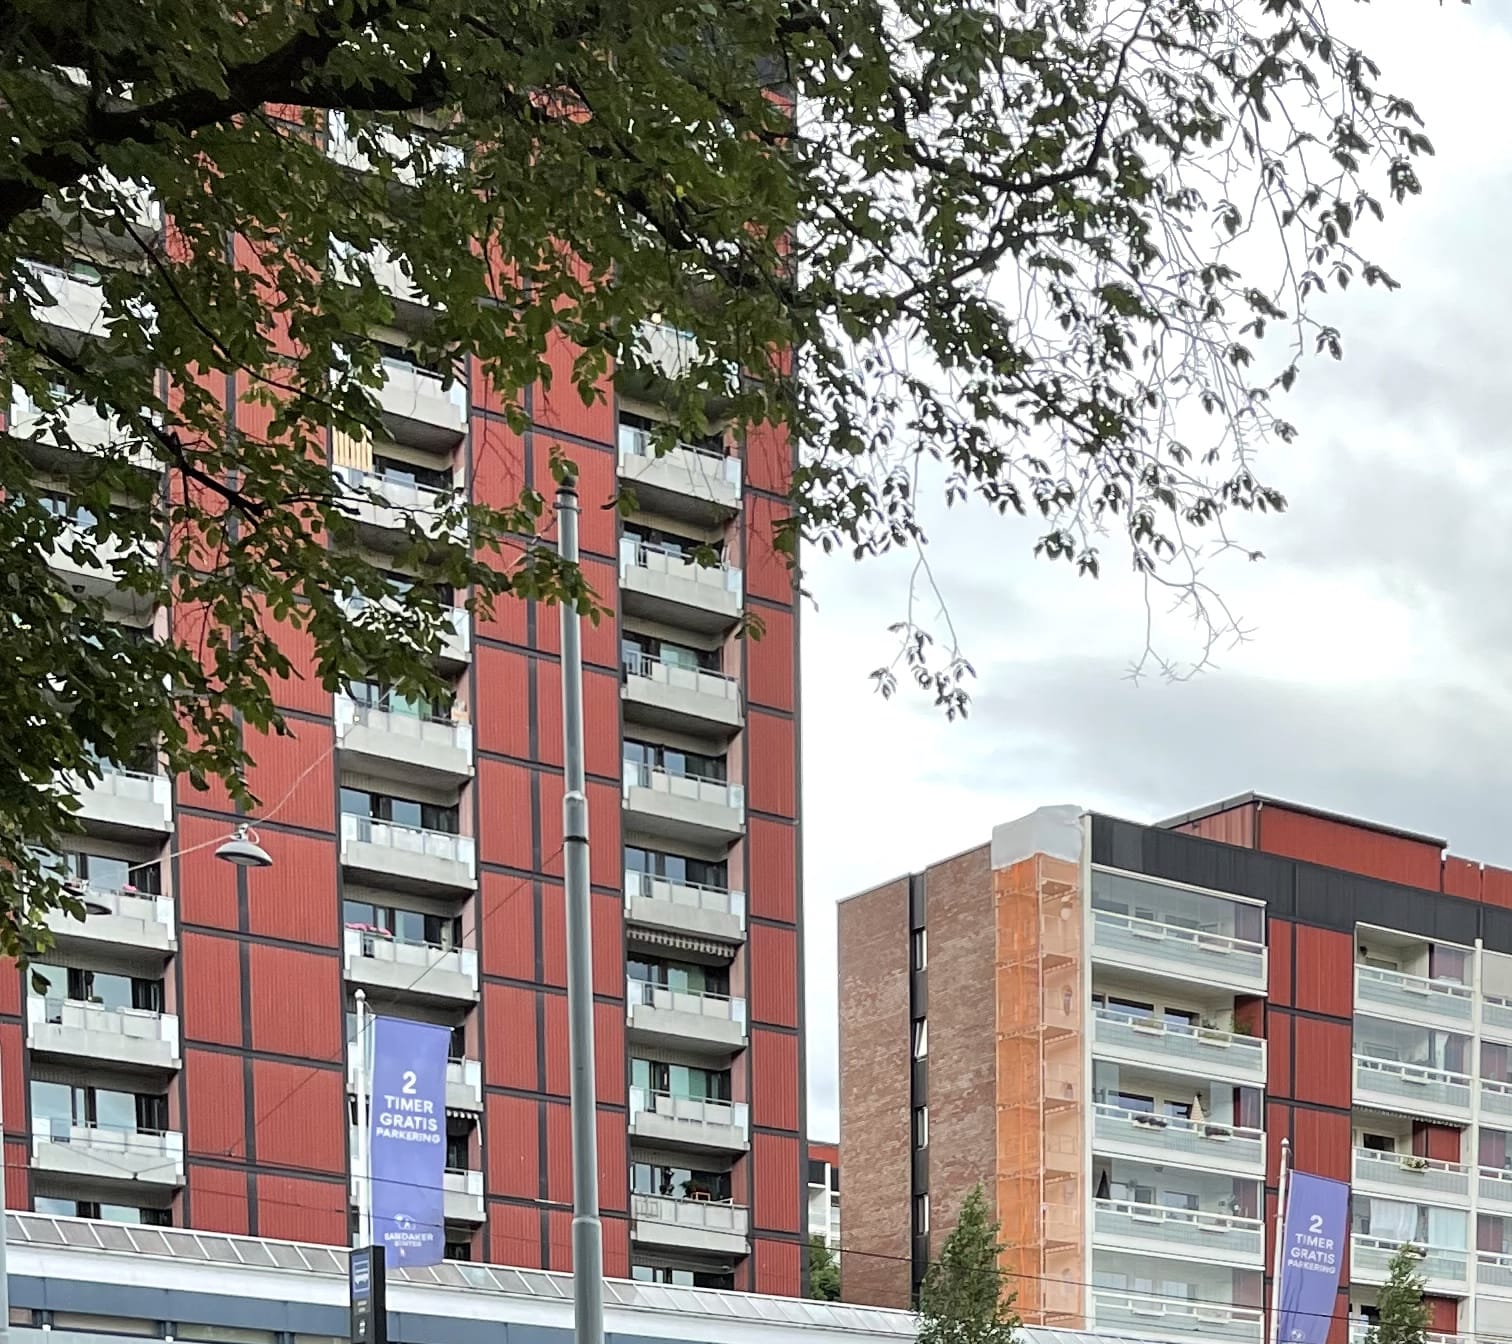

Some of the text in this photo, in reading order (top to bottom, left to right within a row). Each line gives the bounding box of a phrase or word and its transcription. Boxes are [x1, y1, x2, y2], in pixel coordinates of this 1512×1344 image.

[402, 1070, 417, 1094] 2
[384, 1094, 434, 1114] TIMER
[379, 1112, 438, 1132] GRATIS
[1309, 1214, 1323, 1234] 2
[1295, 1233, 1334, 1250] TIMER
[1290, 1247, 1336, 1265] GRATIS
